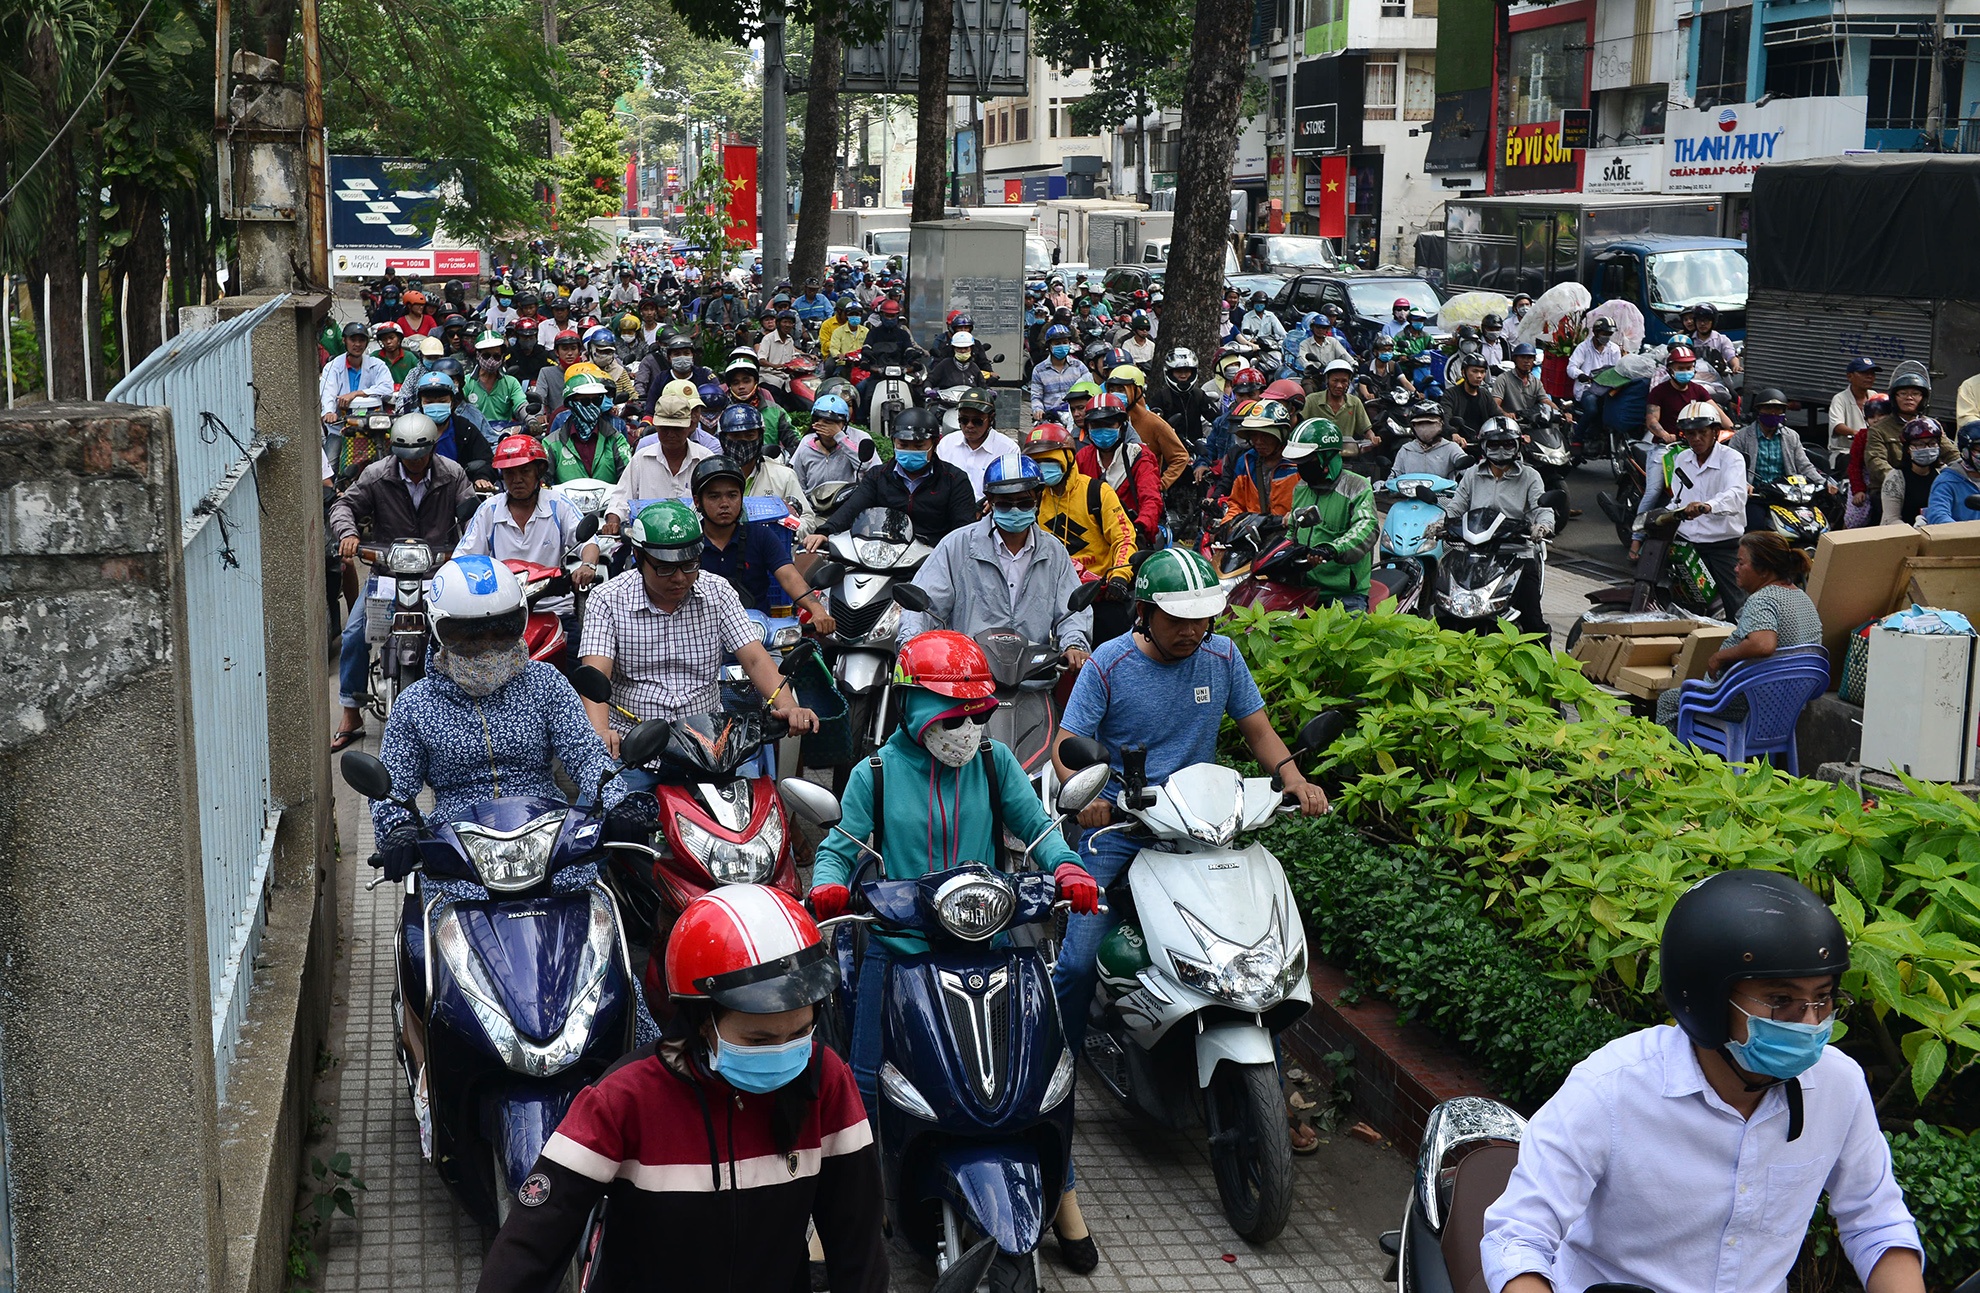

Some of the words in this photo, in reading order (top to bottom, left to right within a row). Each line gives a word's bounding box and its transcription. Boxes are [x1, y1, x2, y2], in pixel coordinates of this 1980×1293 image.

[1506, 126, 1523, 166] ẾP
[1525, 128, 1543, 165] VŨ
[1674, 135, 1730, 163] THANH
[1603, 165, 1631, 181] SABE
[1321, 435, 1340, 444] Grab
[1195, 688, 1207, 696] UNI
[1207, 862, 1240, 871] HONDA
[507, 910, 548, 919] HONDA
[1117, 923, 1144, 949] Grab
[1140, 990, 1165, 1014] HONDA
